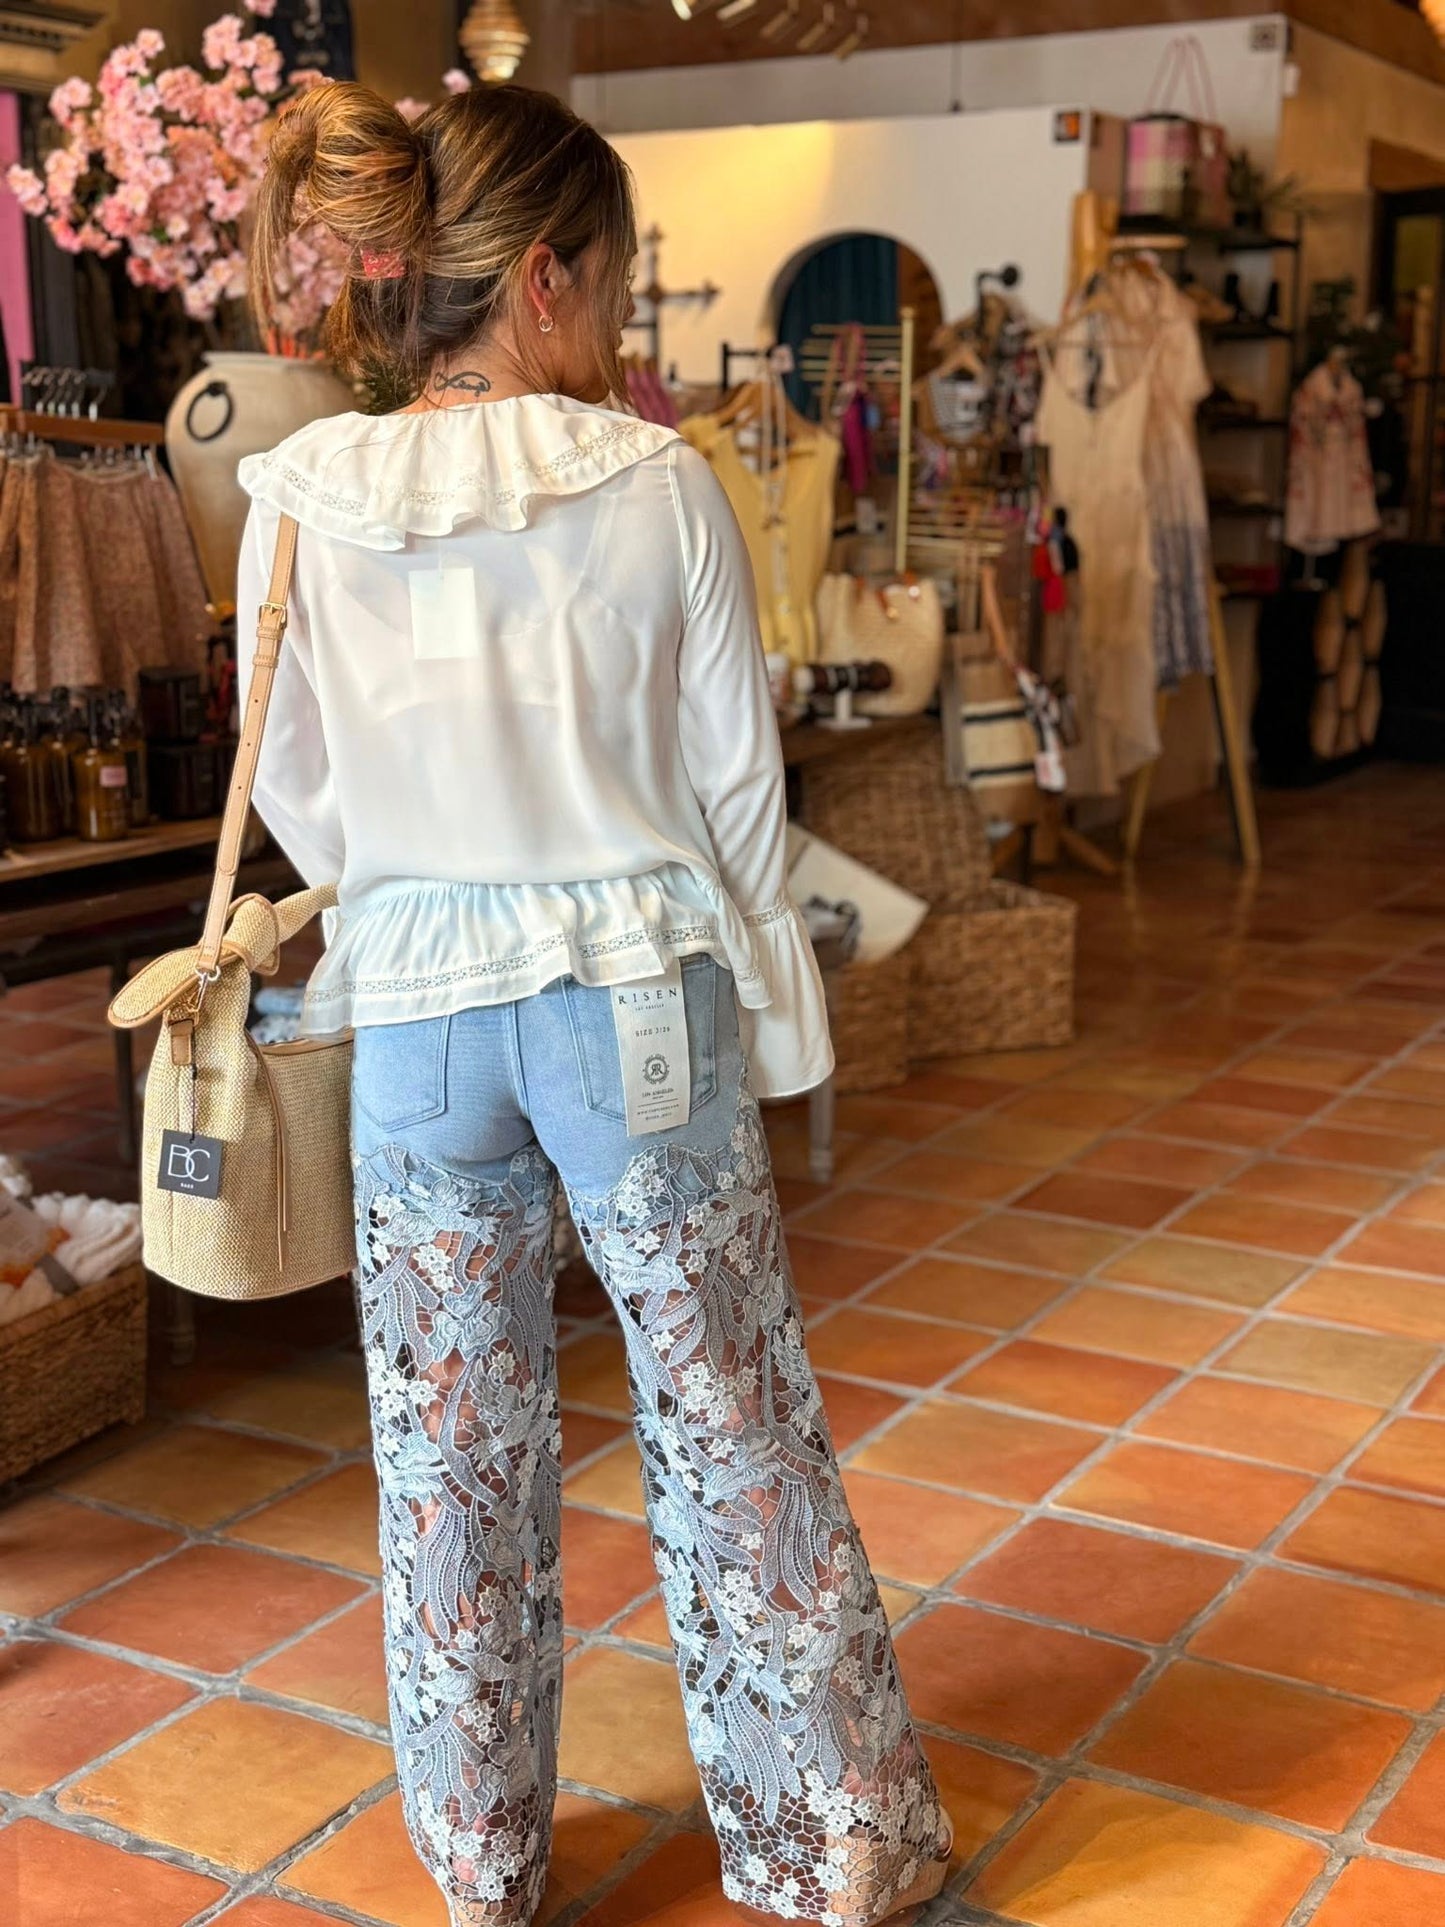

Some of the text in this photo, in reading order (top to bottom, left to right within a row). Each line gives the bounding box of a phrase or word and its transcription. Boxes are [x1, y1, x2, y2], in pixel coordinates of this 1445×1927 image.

[618, 988, 677, 1005] RISEN
[635, 1028, 653, 1037] SIZE
[168, 1144, 210, 1182] BC
